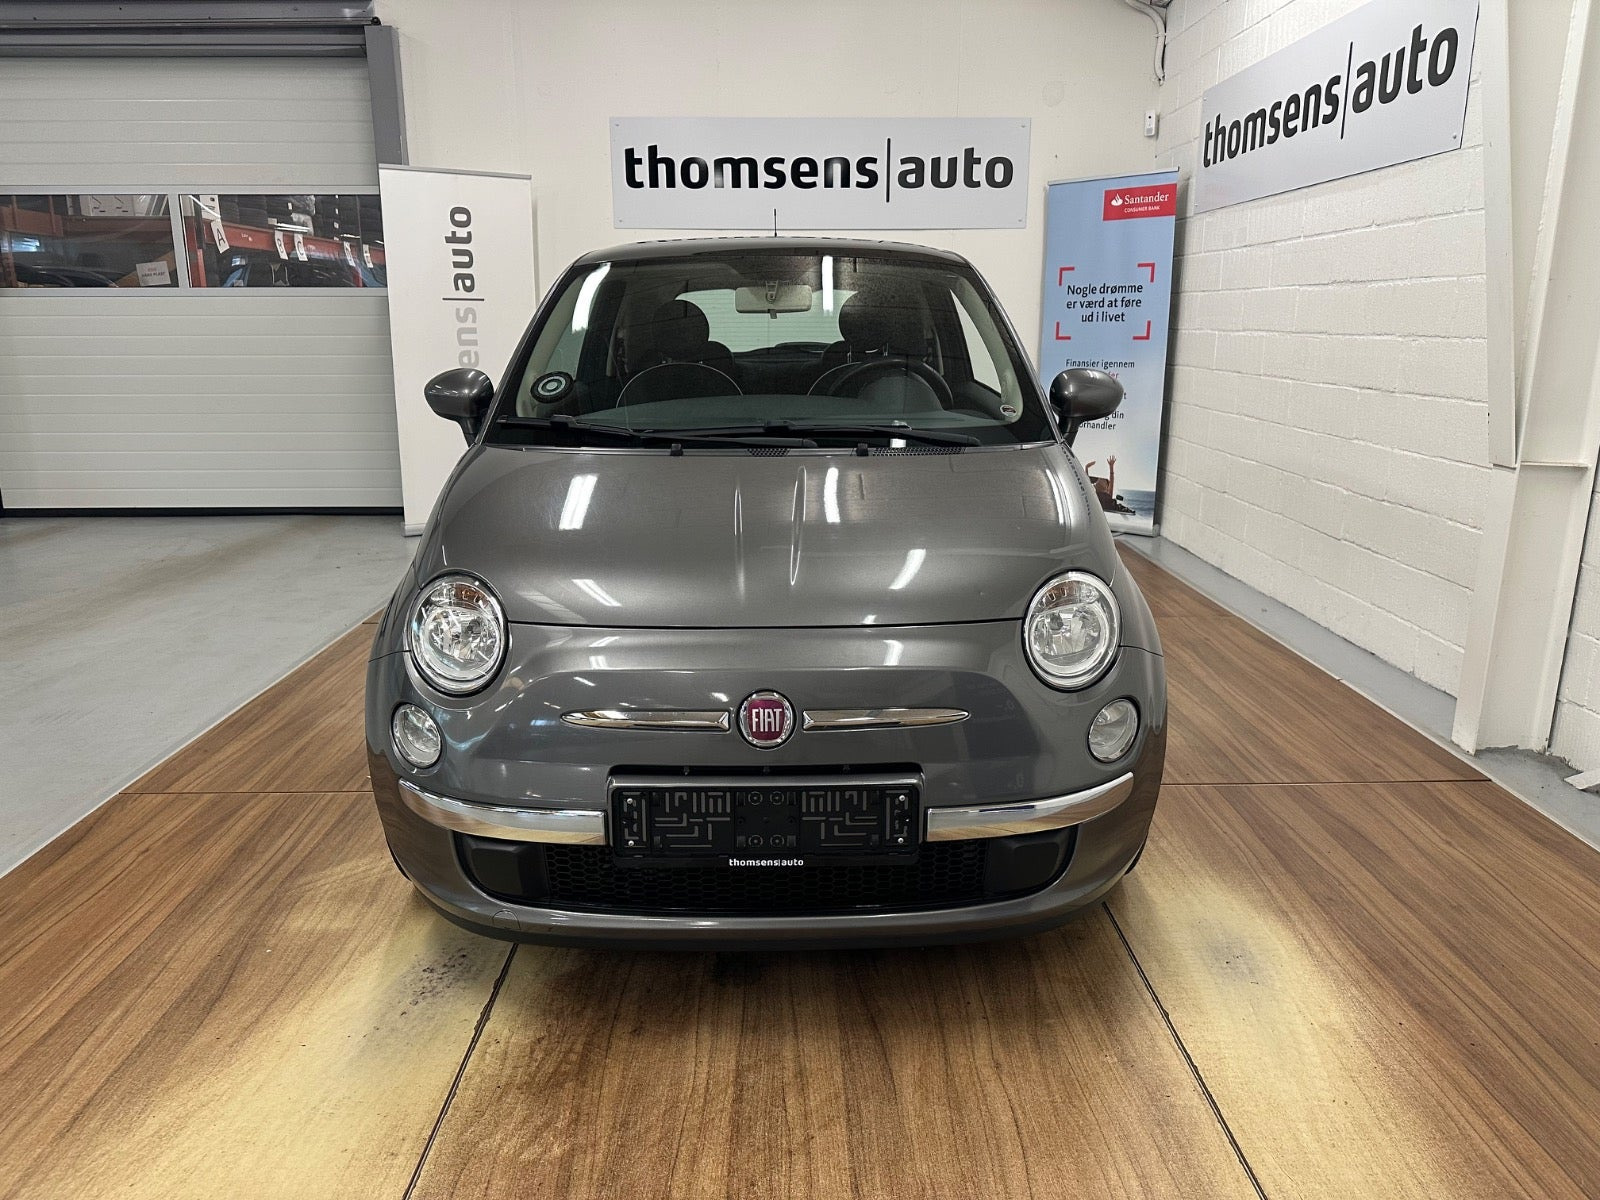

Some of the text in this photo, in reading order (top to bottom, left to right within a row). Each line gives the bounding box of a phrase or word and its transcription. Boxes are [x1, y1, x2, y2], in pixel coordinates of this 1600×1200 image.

[1124, 192, 1169, 205] Santander
[216, 228, 226, 246] A
[1067, 283, 1143, 298] Nogle drømme
[1066, 297, 1142, 309] er værd at føre
[1081, 311, 1125, 322] ud i livet
[1065, 359, 1135, 369] Finansier igennem
[1079, 421, 1116, 430] orhandler
[752, 707, 782, 732] FIAT
